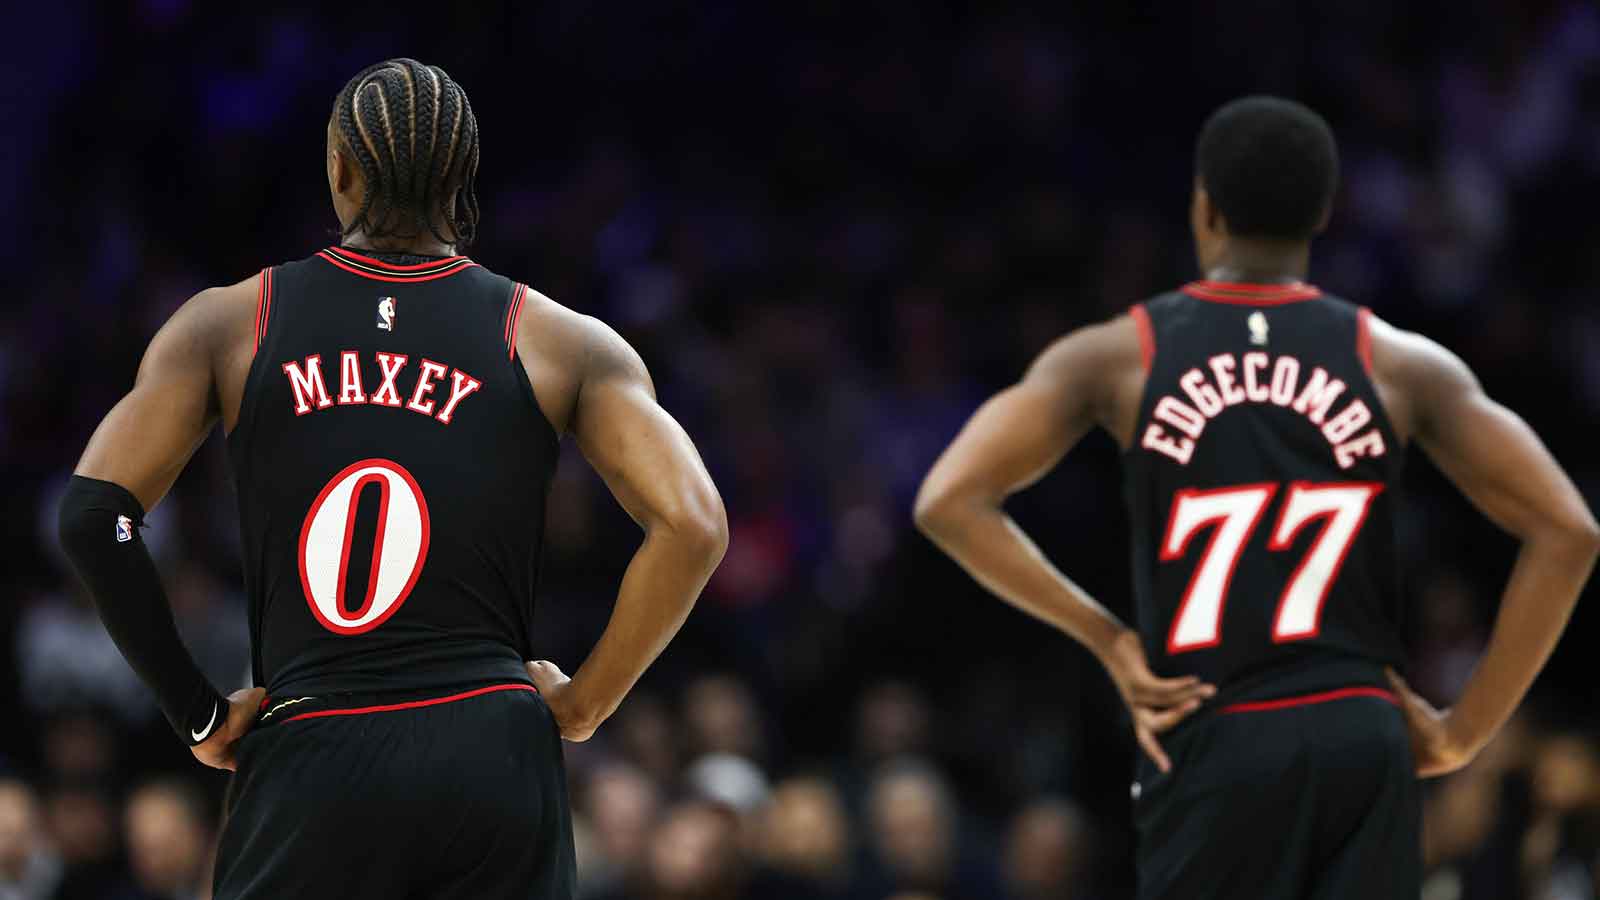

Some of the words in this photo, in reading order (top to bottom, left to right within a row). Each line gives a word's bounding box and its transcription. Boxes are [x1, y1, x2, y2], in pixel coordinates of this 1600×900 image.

[282, 350, 483, 425] MAXEY
[1141, 351, 1386, 469] EDGECOMBE
[297, 458, 431, 636] 0
[1159, 481, 1385, 654] 77
